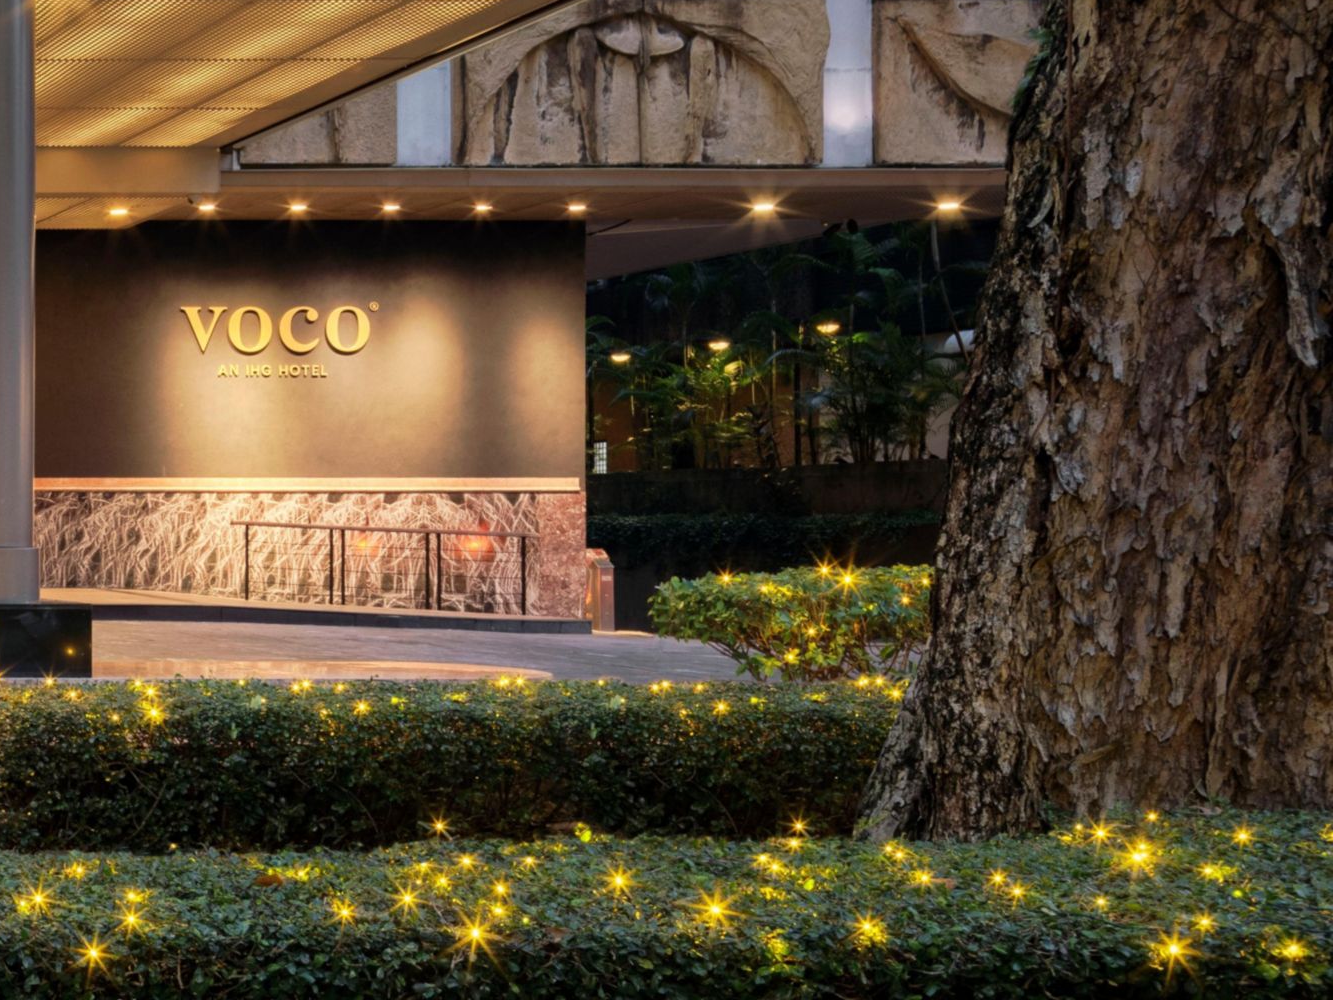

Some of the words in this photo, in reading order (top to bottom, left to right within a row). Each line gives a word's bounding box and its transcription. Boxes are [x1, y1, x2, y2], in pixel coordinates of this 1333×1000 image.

[217, 364, 239, 378] AN
[245, 364, 272, 378] IHG
[278, 364, 328, 378] HOTEL
